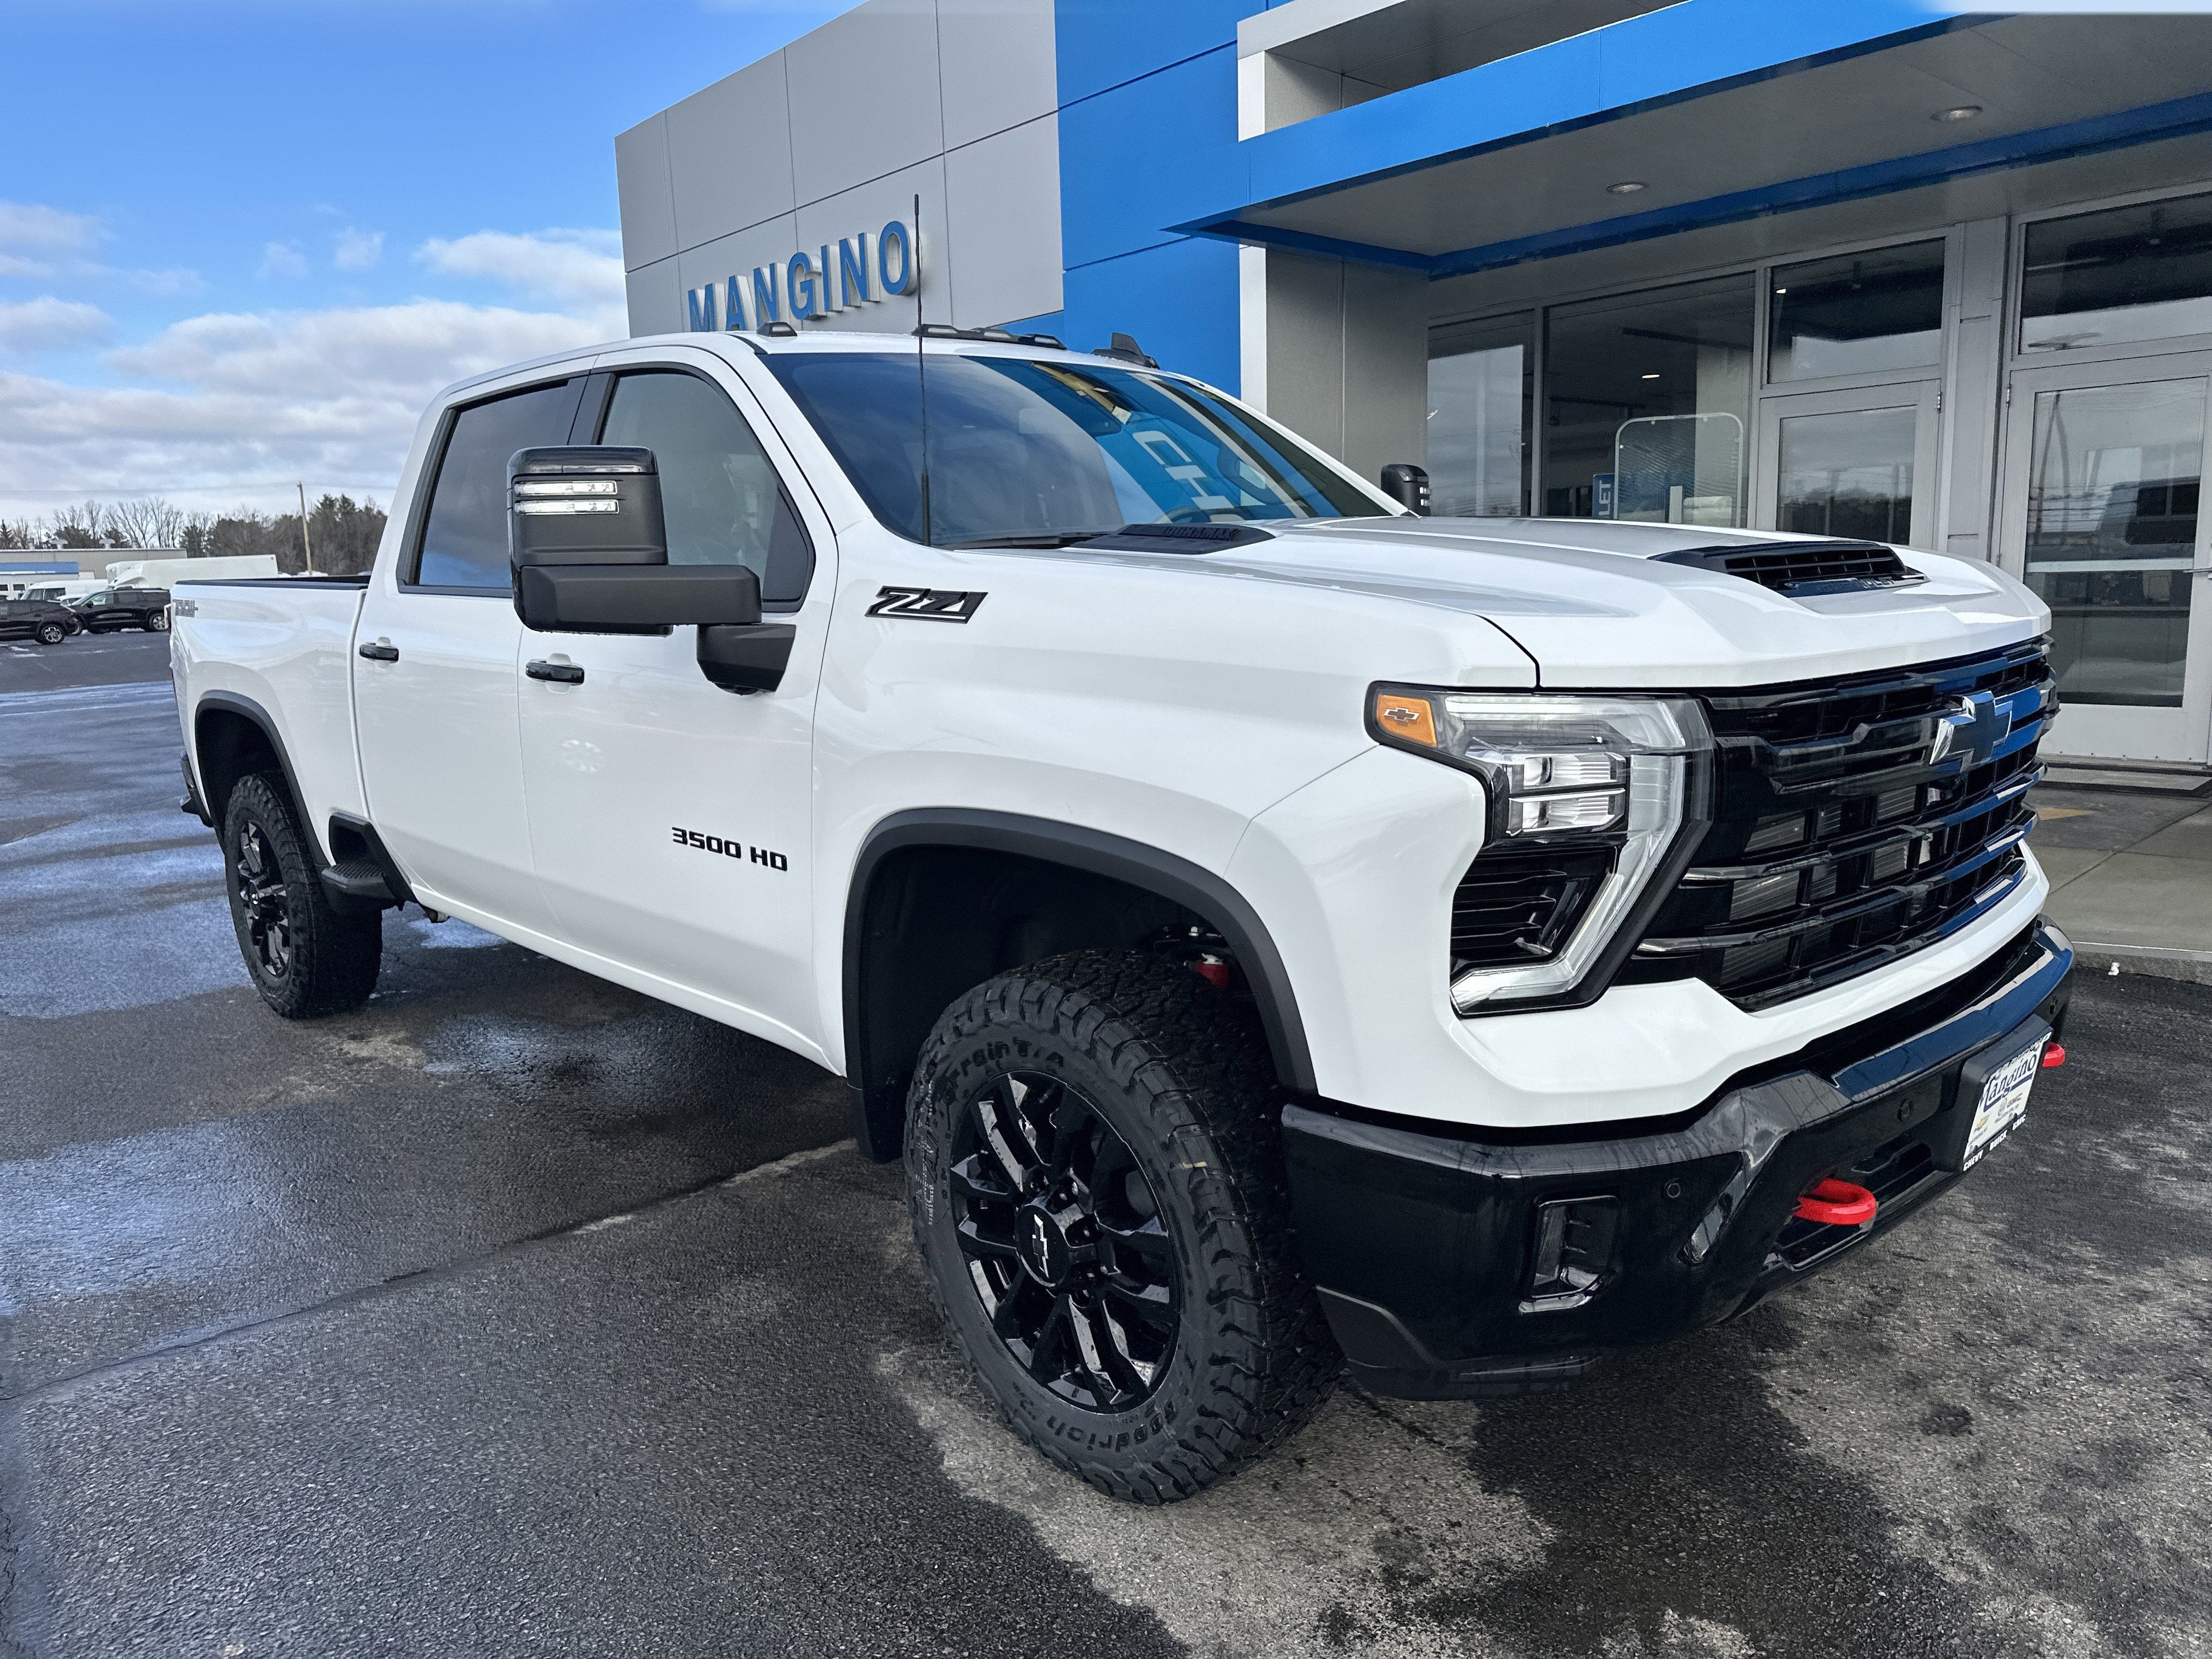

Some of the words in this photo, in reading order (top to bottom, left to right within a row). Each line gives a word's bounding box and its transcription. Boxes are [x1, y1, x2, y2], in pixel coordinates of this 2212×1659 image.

[687, 221, 917, 331] MANGINO
[865, 585, 989, 624] Z71
[672, 826, 742, 859] 3500
[749, 846, 788, 872] HD
